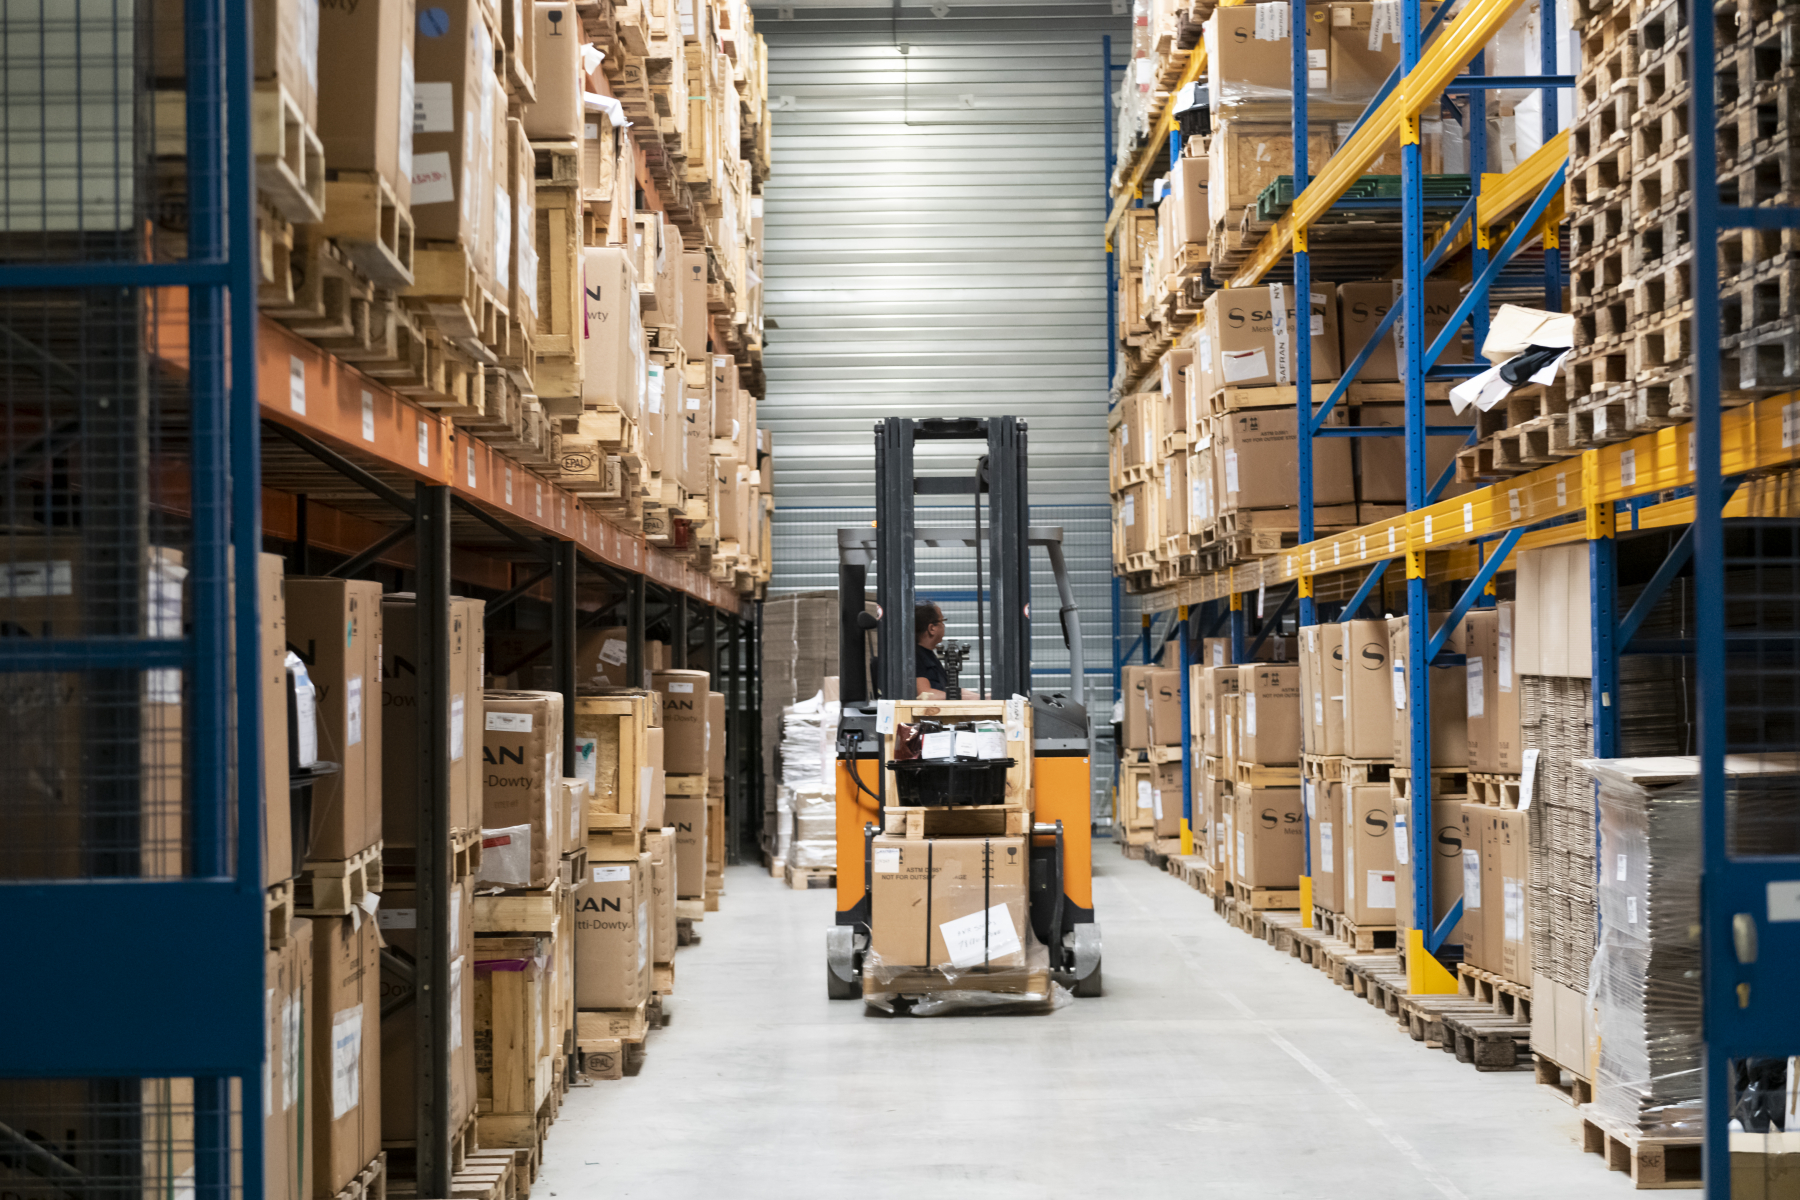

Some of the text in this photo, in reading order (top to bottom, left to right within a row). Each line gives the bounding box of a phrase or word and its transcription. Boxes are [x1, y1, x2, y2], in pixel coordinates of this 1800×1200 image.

[1279, 341, 1287, 383] SAFRAN
[565, 459, 585, 468] EPAL
[590, 1058, 611, 1068] EPAL
